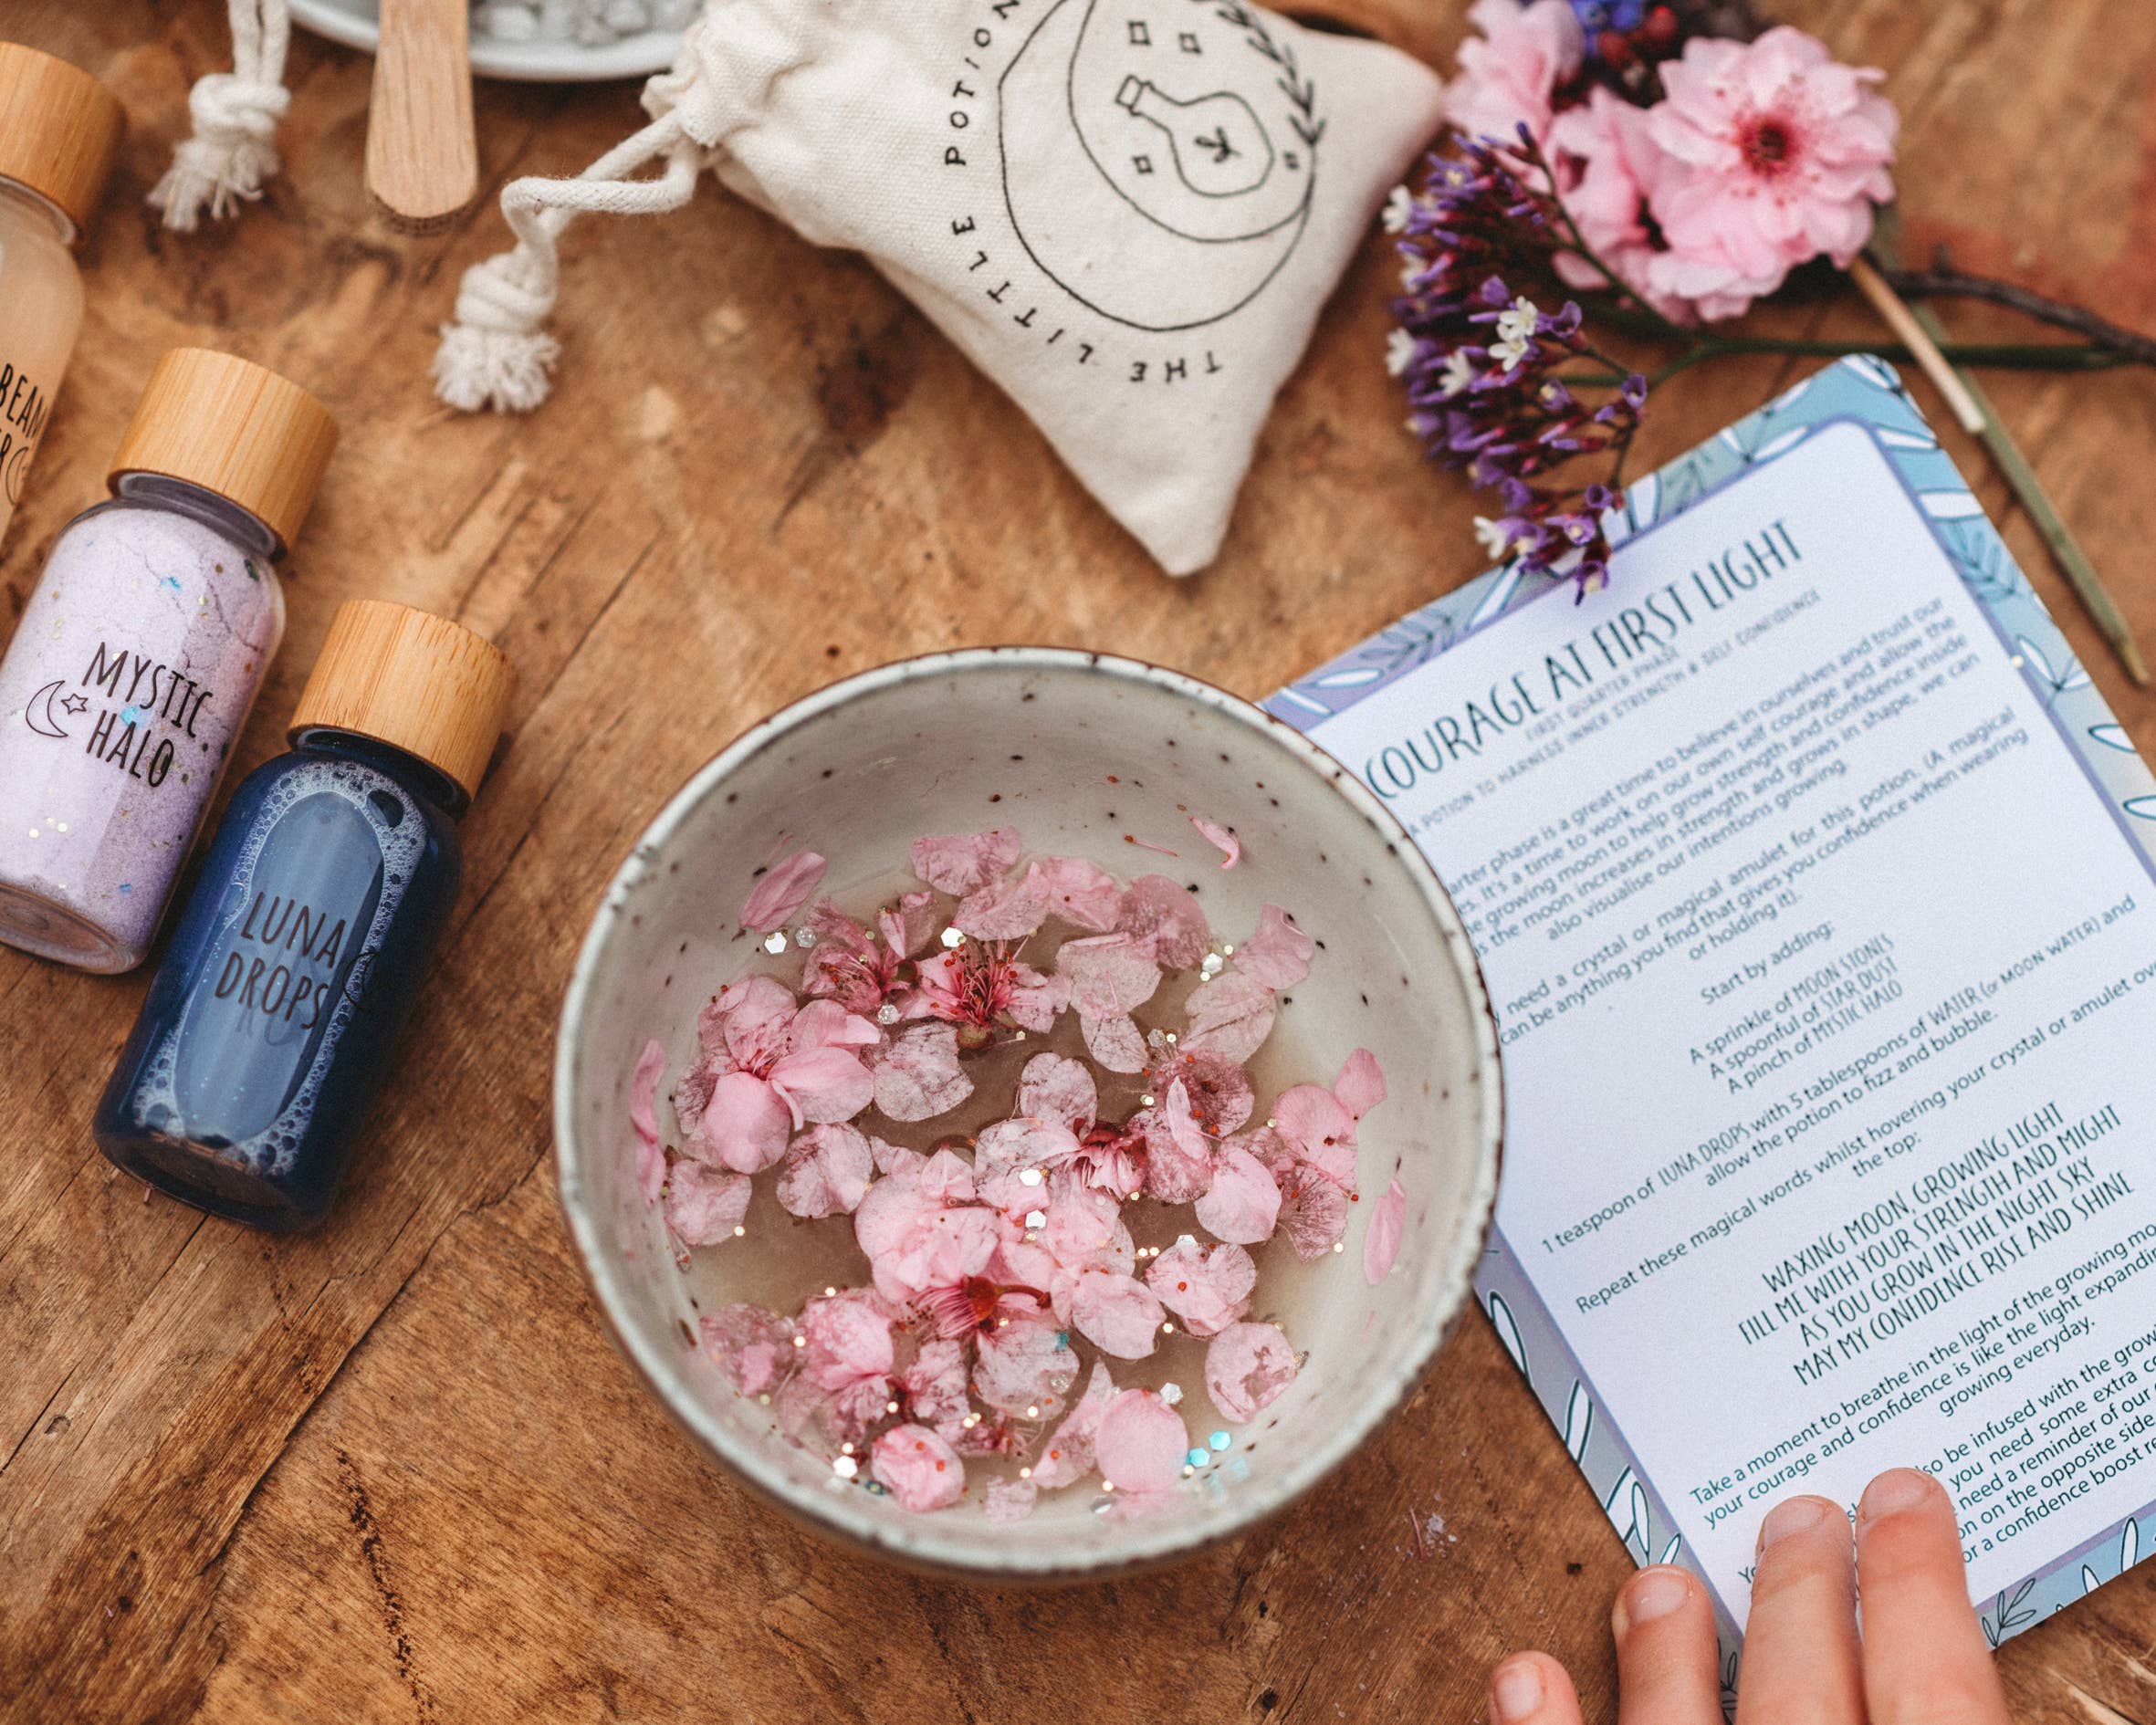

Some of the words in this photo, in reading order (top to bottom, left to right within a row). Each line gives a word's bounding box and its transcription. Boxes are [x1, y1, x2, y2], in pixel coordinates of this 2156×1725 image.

[945, 0, 1019, 166] POTION
[951, 215, 1094, 364] LITTLE
[1129, 350, 1223, 383] THE
[81, 642, 215, 738] MYSTIC
[1365, 671, 1546, 800] COURAGE
[1543, 638, 1595, 703] AT
[1589, 580, 1695, 671] FIRST
[1690, 517, 1803, 612] LIGHT
[86, 709, 175, 789] HALO
[240, 892, 346, 968] LUNA
[1493, 1021, 1532, 1047] can
[1527, 1007, 1555, 1029] be
[1554, 962, 1634, 1014] anything
[1629, 942, 1666, 973] you
[1662, 915, 1701, 950] find
[1699, 898, 1738, 929] that
[1737, 873, 1784, 910] gives
[1781, 853, 1817, 884] you
[1816, 798, 1909, 861] confidence
[1909, 769, 1960, 804] when
[1957, 727, 2029, 775] wearing
[1688, 941, 1708, 961] or
[1706, 903, 1779, 949] holding
[215, 951, 329, 1030] DROPS
[1505, 978, 1552, 1016] need
[1554, 973, 1569, 988] a
[1571, 934, 1628, 978] crystal
[1631, 923, 1651, 943] or
[1689, 1047, 1706, 1065] A
[1704, 1009, 1774, 1056] sprinkle
[1774, 990, 1794, 1015] of
[1790, 961, 1842, 1003] MOON
[1838, 932, 1895, 975] STONES
[1700, 972, 1745, 1006] Start
[1742, 958, 1768, 980] by
[1769, 920, 1836, 967] adding:
[1709, 1061, 1726, 1081] A
[1724, 1014, 1802, 1071] spoonful
[1802, 1000, 1821, 1024] of
[1818, 979, 1862, 1011] STAR
[1856, 956, 1899, 991] DUST
[1542, 1239, 1554, 1254] 1
[1554, 1194, 1637, 1248] teaspoon
[1636, 1176, 1656, 1200] of
[1657, 1151, 1702, 1187] LUNA
[1697, 1122, 1752, 1164] DROPS
[1749, 1103, 1792, 1133] with
[1787, 1092, 1804, 1111] 5
[1803, 1033, 1910, 1102] tablespoons
[1909, 1016, 1928, 1040] of
[1927, 987, 1983, 1027] WATER
[1999, 949, 2046, 985] MOON
[2101, 894, 2136, 925] and
[1705, 1151, 1752, 1187] allow
[1751, 1134, 1784, 1158] the
[1784, 1099, 1843, 1144] potion
[1841, 1086, 1864, 1105] to
[1862, 1067, 1897, 1092] fizz
[1896, 1042, 1931, 1074] and
[1928, 1009, 1998, 1053] bubble.
[1727, 1077, 1743, 1095] A
[1743, 1048, 1794, 1089] pinch
[1794, 1031, 1814, 1055] of
[1810, 1002, 1864, 1043] MYSTIC
[1858, 978, 1903, 1014] HALO
[1575, 1270, 1639, 1314] Repeat
[1638, 1242, 1689, 1278] these
[1689, 1197, 1758, 1249] magical
[1758, 1168, 1813, 1207] words
[1814, 1134, 1868, 1174] whilst
[1866, 1091, 1947, 1143] hovering
[1946, 1064, 1986, 1100] your
[1989, 1026, 2046, 1071] crystal
[2048, 1017, 2067, 1036] or
[2070, 978, 2132, 1023] amulet
[1761, 1232, 1847, 1293] WAXING
[1843, 1190, 1917, 1246] MOON,
[1911, 1135, 2010, 1205] GROWING
[2006, 1102, 2064, 1149] LIGHT
[1851, 1154, 1884, 1178] the
[1883, 1131, 1922, 1159] top:
[1738, 1310, 1779, 1345] FILL
[1774, 1291, 1808, 1323] ME
[1804, 1260, 1860, 1305] WITH
[1855, 1228, 1920, 1274] YOUR
[1912, 1169, 2013, 1242] STRENGTH
[2012, 1143, 2057, 1186] AND
[2056, 1104, 2121, 1156] MIGHT
[1793, 1344, 1838, 1386] MAY
[1837, 1326, 1869, 1360] MY
[1869, 1260, 1983, 1341] CONFIDENCE
[1980, 1235, 2026, 1275] RISE
[2026, 1208, 2072, 1249] AND
[2071, 1171, 2134, 1221] SHINE
[1799, 1314, 1829, 1348] AS
[1825, 1290, 1871, 1328] YOU
[1870, 1250, 1934, 1302] GROW
[1932, 1233, 1961, 1267] IN
[1957, 1214, 1999, 1251] THE
[1994, 1177, 2058, 1229] NIGHT
[2056, 1155, 2095, 1193] SKY
[1689, 1476, 1733, 1505] Take
[1733, 1468, 1747, 1482] a
[1746, 1422, 1823, 1474] moment
[1820, 1411, 1842, 1429] to
[1839, 1371, 1910, 1417] breathe
[1908, 1359, 1931, 1377] in
[1929, 1341, 1962, 1365] the
[1958, 1314, 2004, 1347] light
[2004, 1298, 2023, 1322] of
[2022, 1285, 2055, 1310] the
[2055, 1242, 2129, 1296] growing
[1703, 1494, 1743, 1531] your
[1748, 1452, 1818, 1500] courage
[1820, 1425, 1856, 1458] and
[1858, 1373, 1953, 1435] confidence
[1952, 1361, 1972, 1378] is
[1970, 1342, 2005, 1367] like
[2005, 1322, 2038, 1346] the
[2037, 1294, 2082, 1327] light
[1939, 1364, 2013, 1417] growing
[2013, 1316, 2096, 1370] everyday.
[1942, 1443, 1971, 1464] be
[1969, 1398, 2037, 1448] infused
[2037, 1377, 2079, 1408] with
[2079, 1359, 2112, 1384] the
[2113, 1331, 2156, 1368] grow
[1949, 1461, 1984, 1493] you
[1988, 1427, 2035, 1466] need
[2038, 1400, 2088, 1437] some
[2093, 1370, 2139, 1403] extra
[1958, 1472, 2004, 1511] need
[2004, 1469, 2018, 1483] a
[2018, 1419, 2098, 1475] reminder
[2099, 1402, 2119, 1426] of
[2120, 1387, 2151, 1414] our
[1980, 1504, 2005, 1524] on
[2005, 1484, 2038, 1509] the
[2040, 1437, 2118, 1489] opposite
[2119, 1414, 2154, 1443] side
[1981, 1538, 1994, 1552] a
[1995, 1479, 2091, 1542] confidence
[2088, 1446, 2144, 1486] boost
